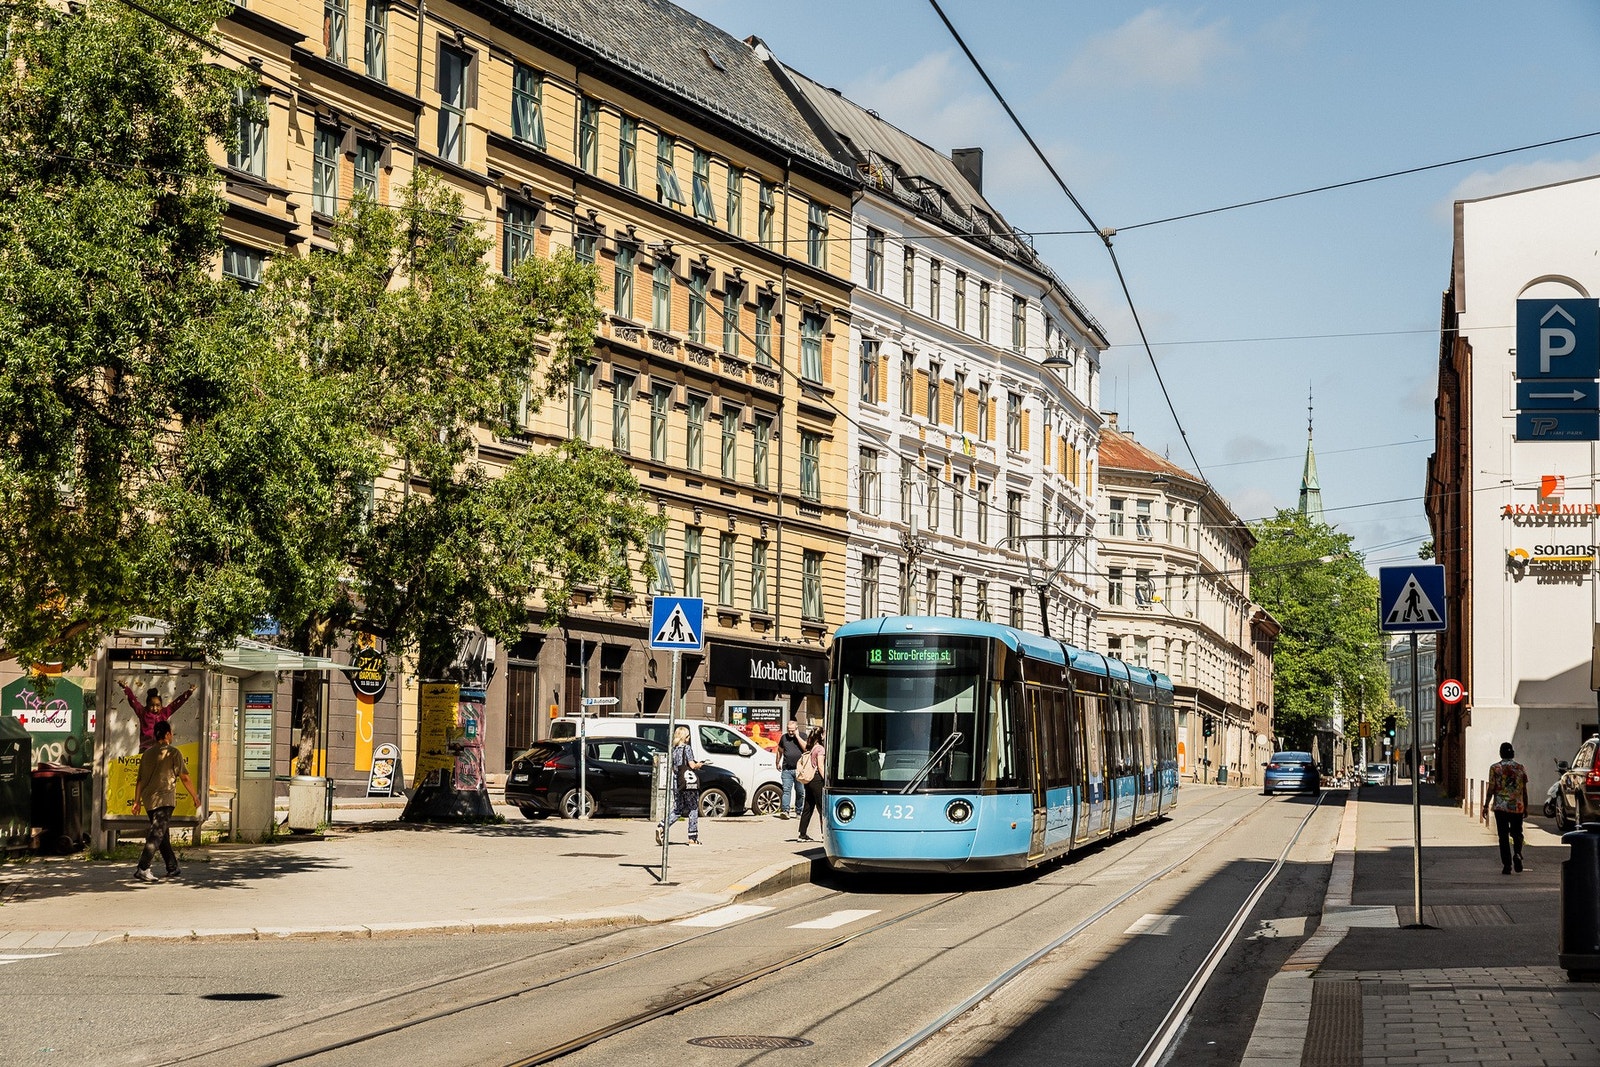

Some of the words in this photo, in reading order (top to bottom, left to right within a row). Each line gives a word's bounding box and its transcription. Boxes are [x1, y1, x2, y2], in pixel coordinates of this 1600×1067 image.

[1540, 328, 1576, 372] P
[1534, 544, 1596, 556] sonans
[870, 649, 882, 662] 18
[888, 649, 940, 661] Storo-Grefsen
[750, 658, 787, 682] Mother
[787, 663, 812, 685] India
[1444, 686, 1459, 697] 30
[31, 716, 48, 724] Røde
[882, 804, 914, 820] 432
